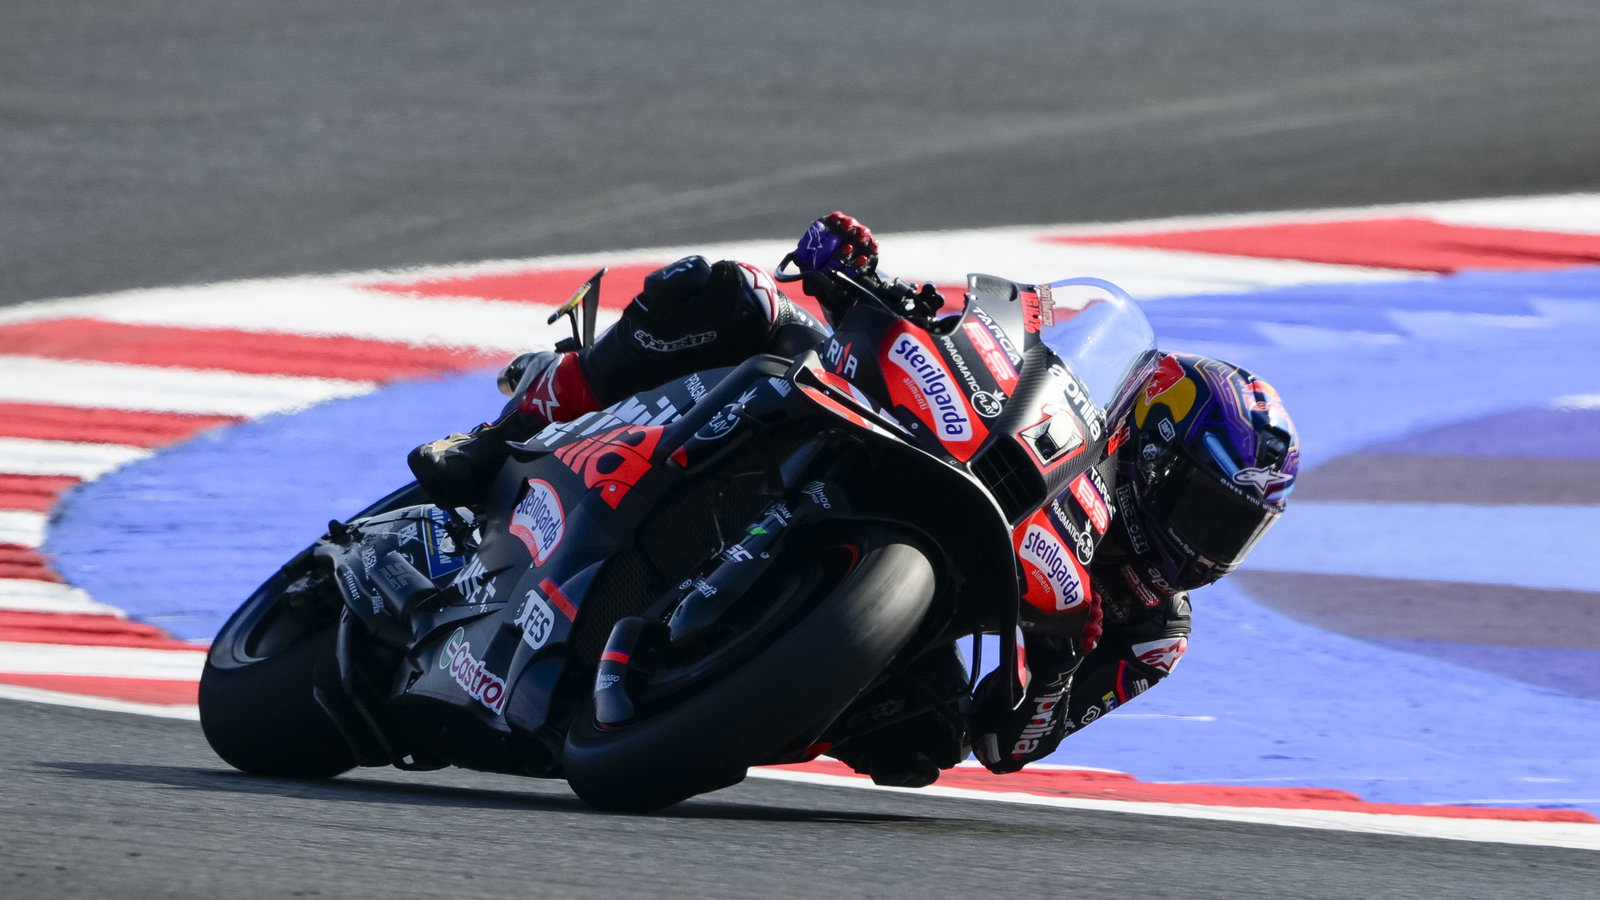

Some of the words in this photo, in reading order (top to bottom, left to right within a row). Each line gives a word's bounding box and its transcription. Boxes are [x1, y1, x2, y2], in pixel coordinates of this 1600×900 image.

[972, 306, 1020, 366] TARGA
[895, 338, 966, 437] sterilgarda
[902, 376, 928, 411] alimenti
[940, 335, 980, 393] PRAGMATIC
[977, 392, 999, 416] PLAY
[1051, 498, 1081, 544] PRAGMATIC
[1078, 538, 1092, 561] PLAY
[1024, 530, 1080, 606] sterilgarda
